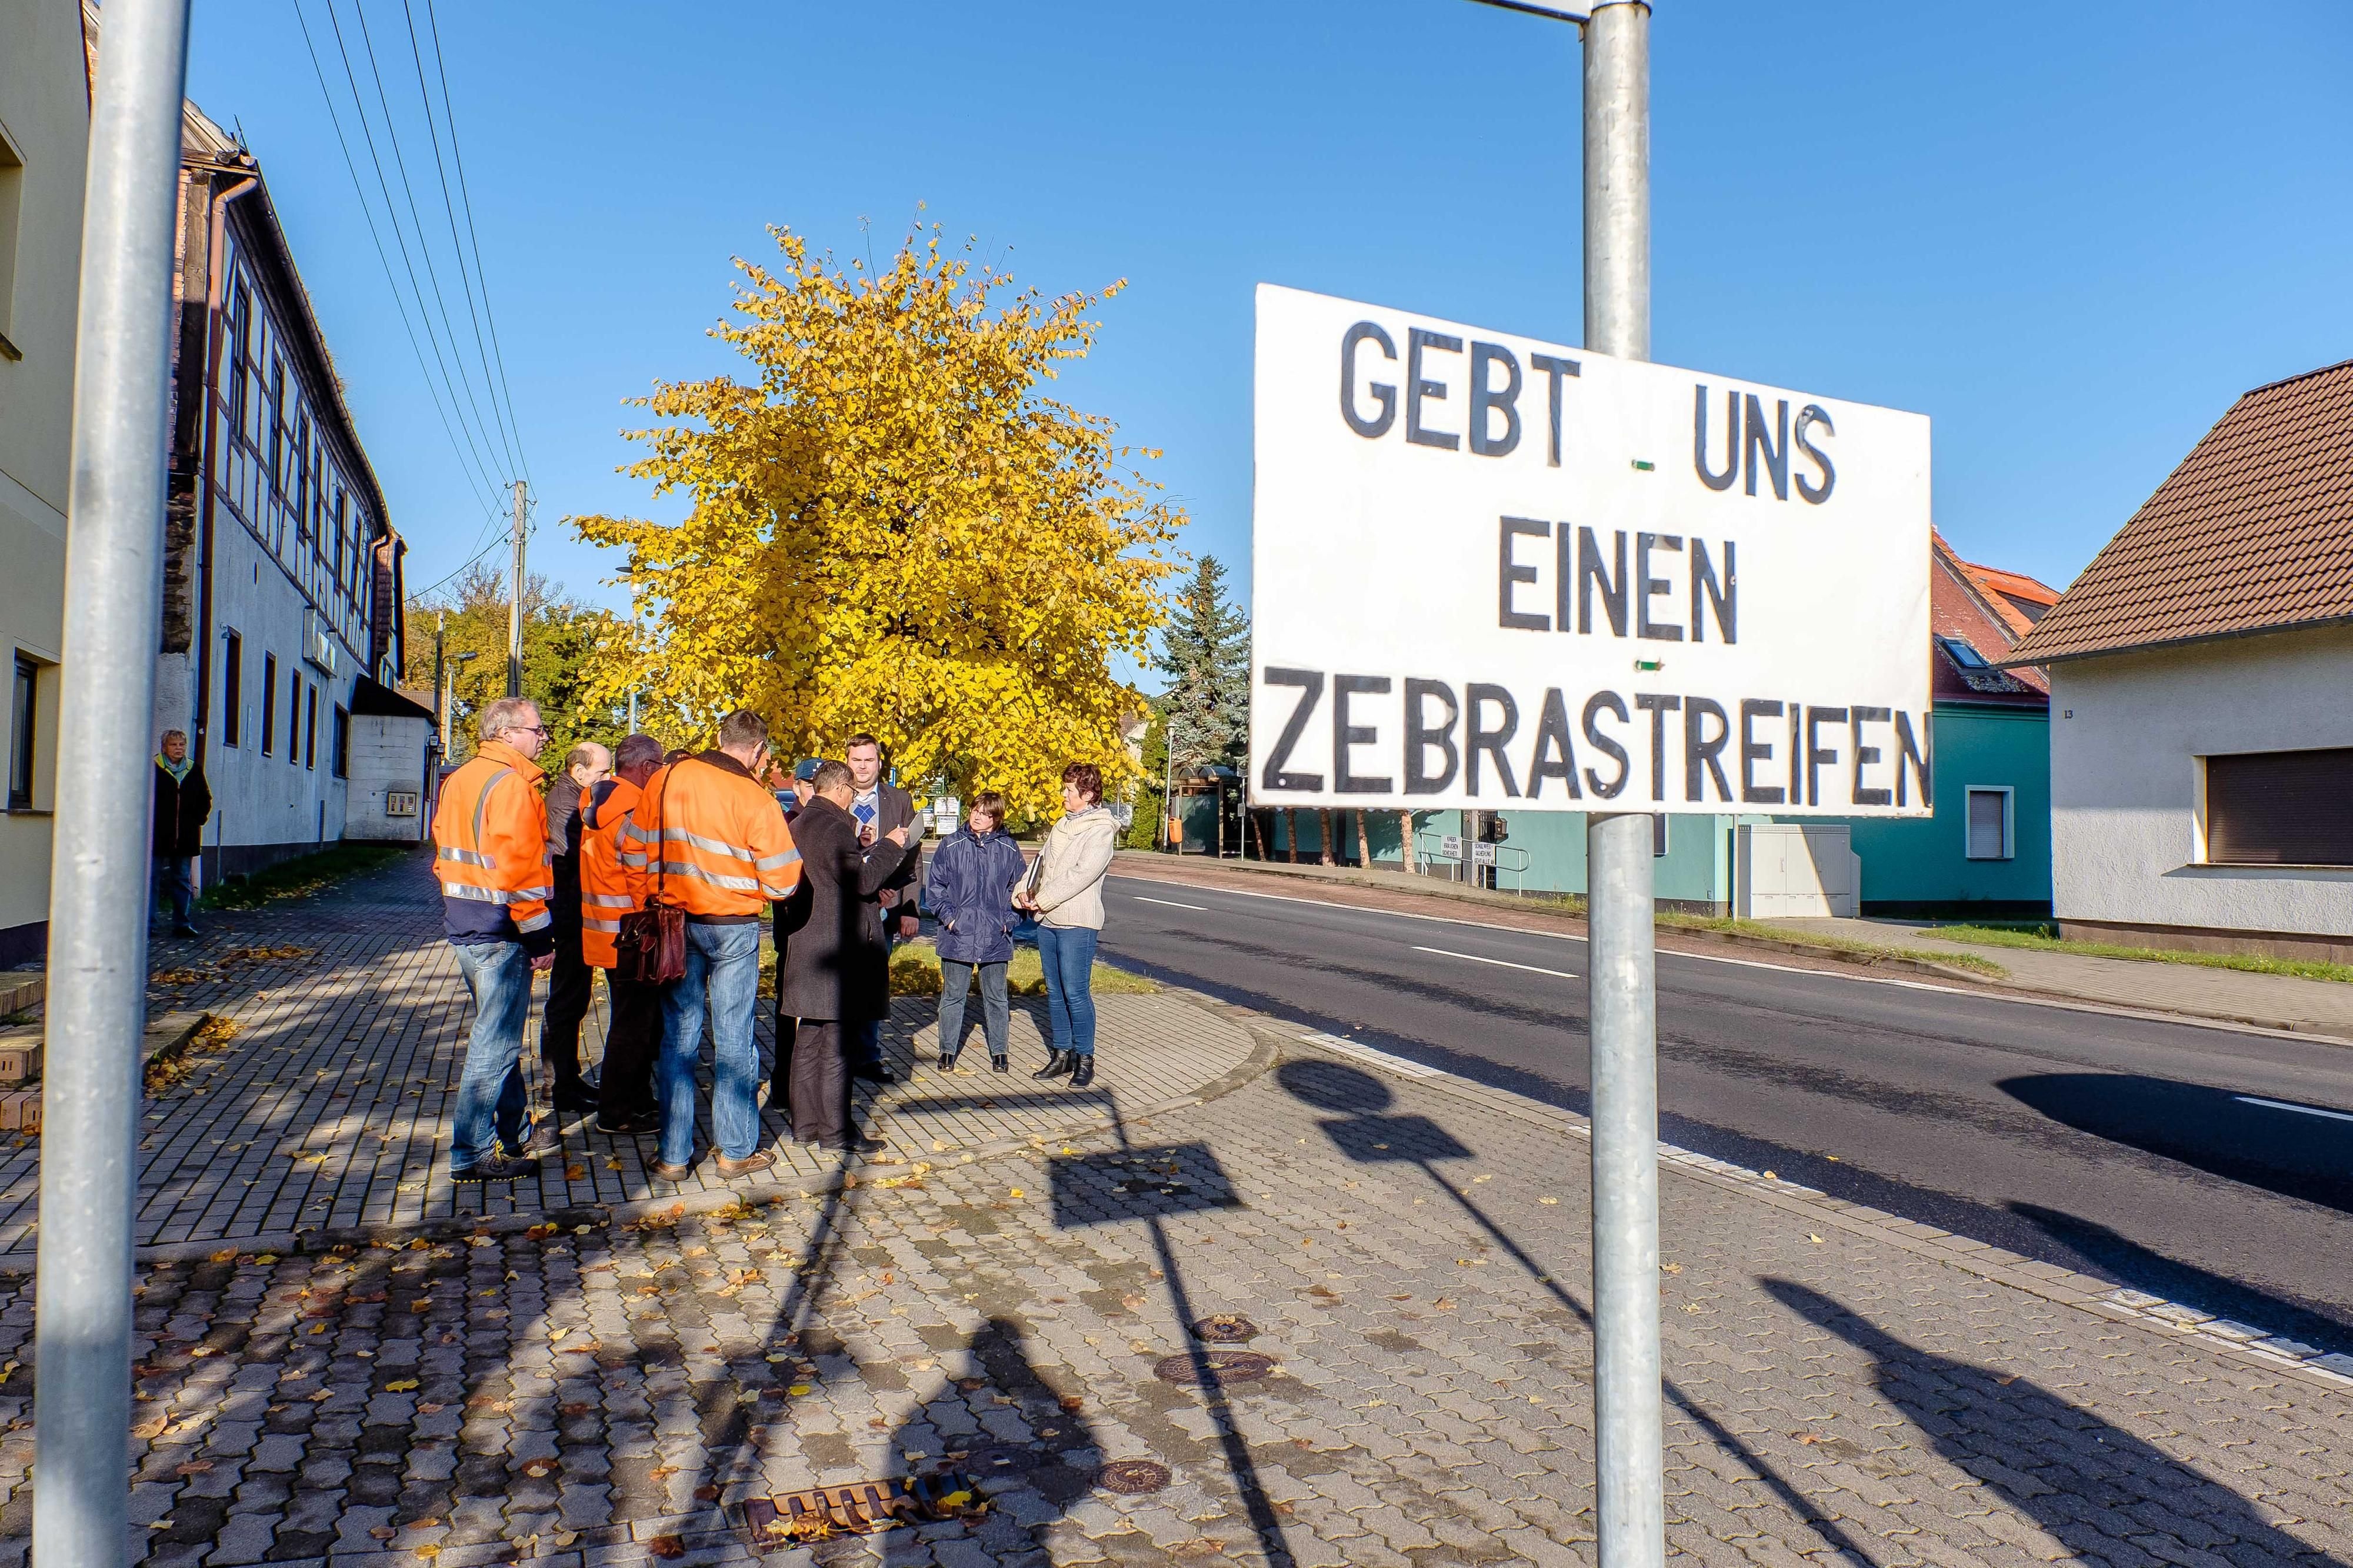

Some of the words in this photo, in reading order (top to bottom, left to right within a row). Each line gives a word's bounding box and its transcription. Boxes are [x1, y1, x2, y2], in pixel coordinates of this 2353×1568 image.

[1341, 320, 1581, 468] GEBT
[1694, 383, 1837, 505] UNS
[1498, 515, 1737, 645] EINEN
[1261, 666, 1933, 808] ZEBRASTREIFEN
[2064, 710, 2074, 719] 13
